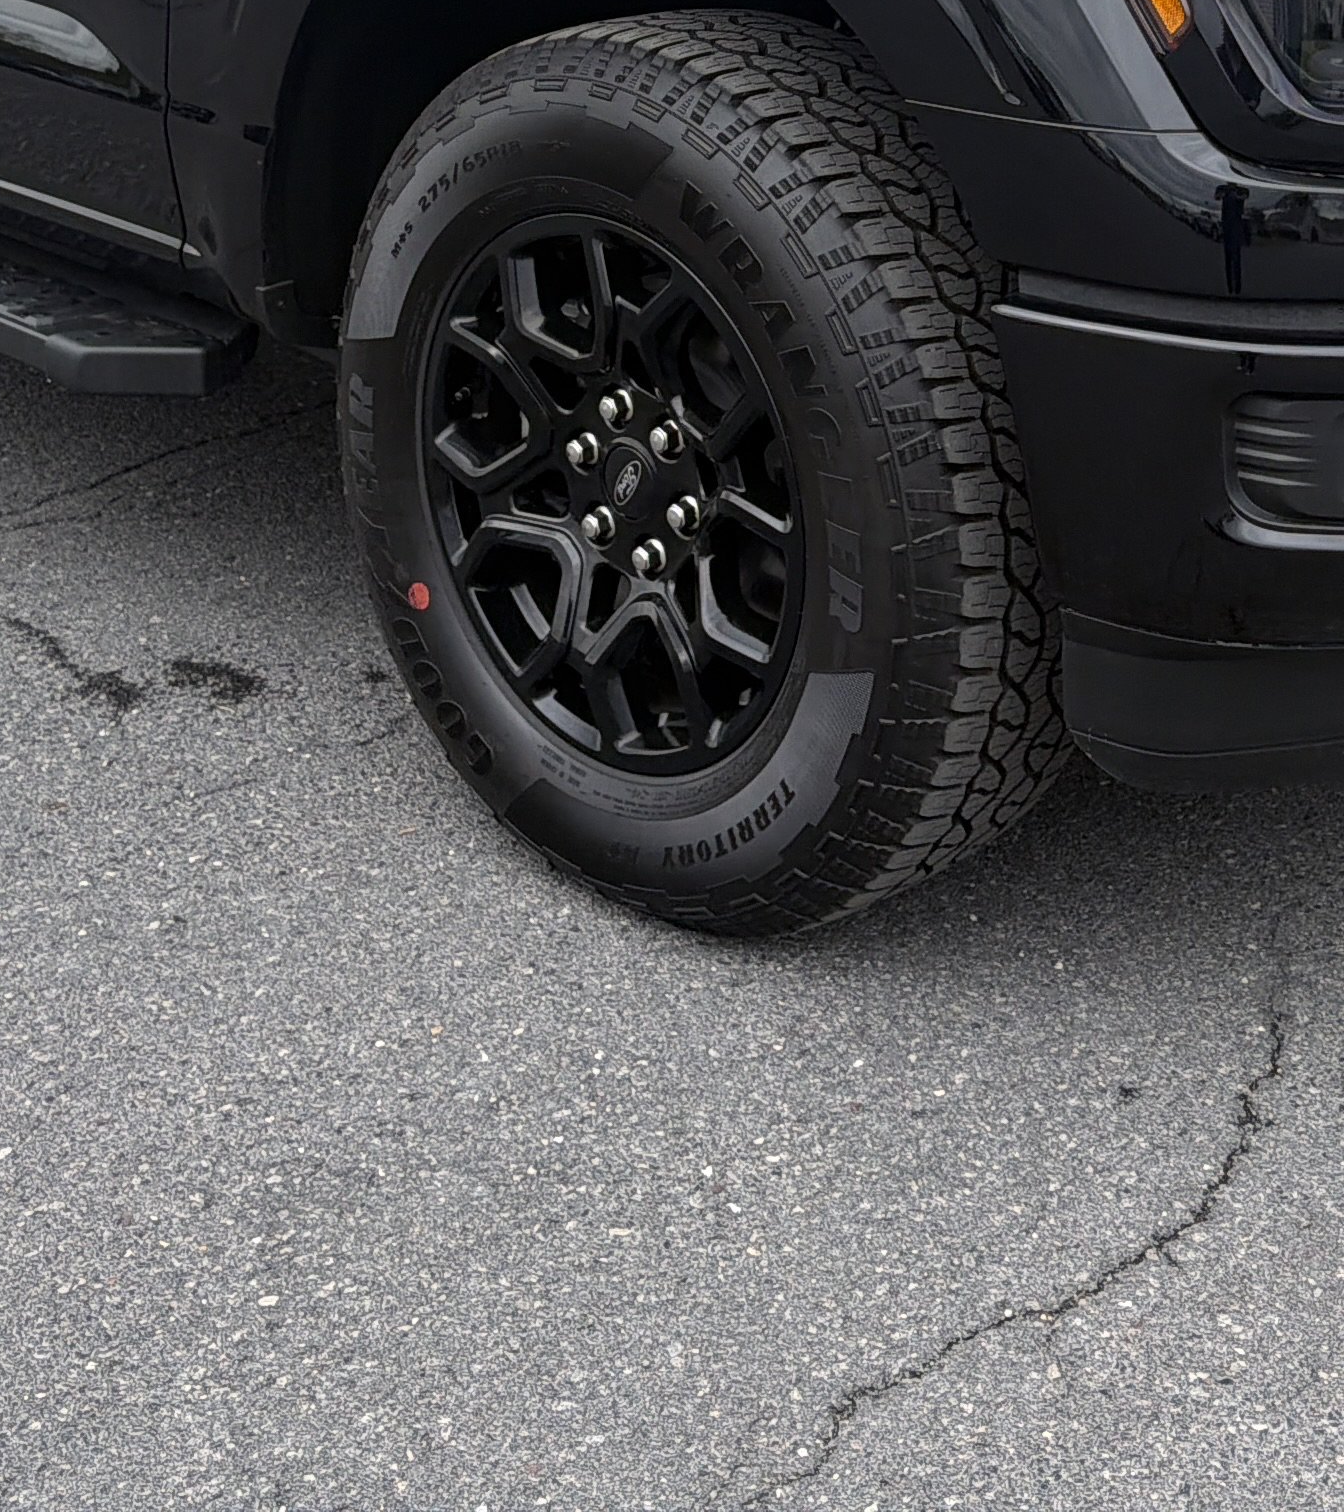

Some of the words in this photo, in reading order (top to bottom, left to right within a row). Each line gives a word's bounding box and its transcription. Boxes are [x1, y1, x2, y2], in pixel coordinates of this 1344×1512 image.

[678, 181, 865, 635] WRANGLER
[617, 466, 637, 500] Ford
[661, 777, 796, 872] TERRITORY
